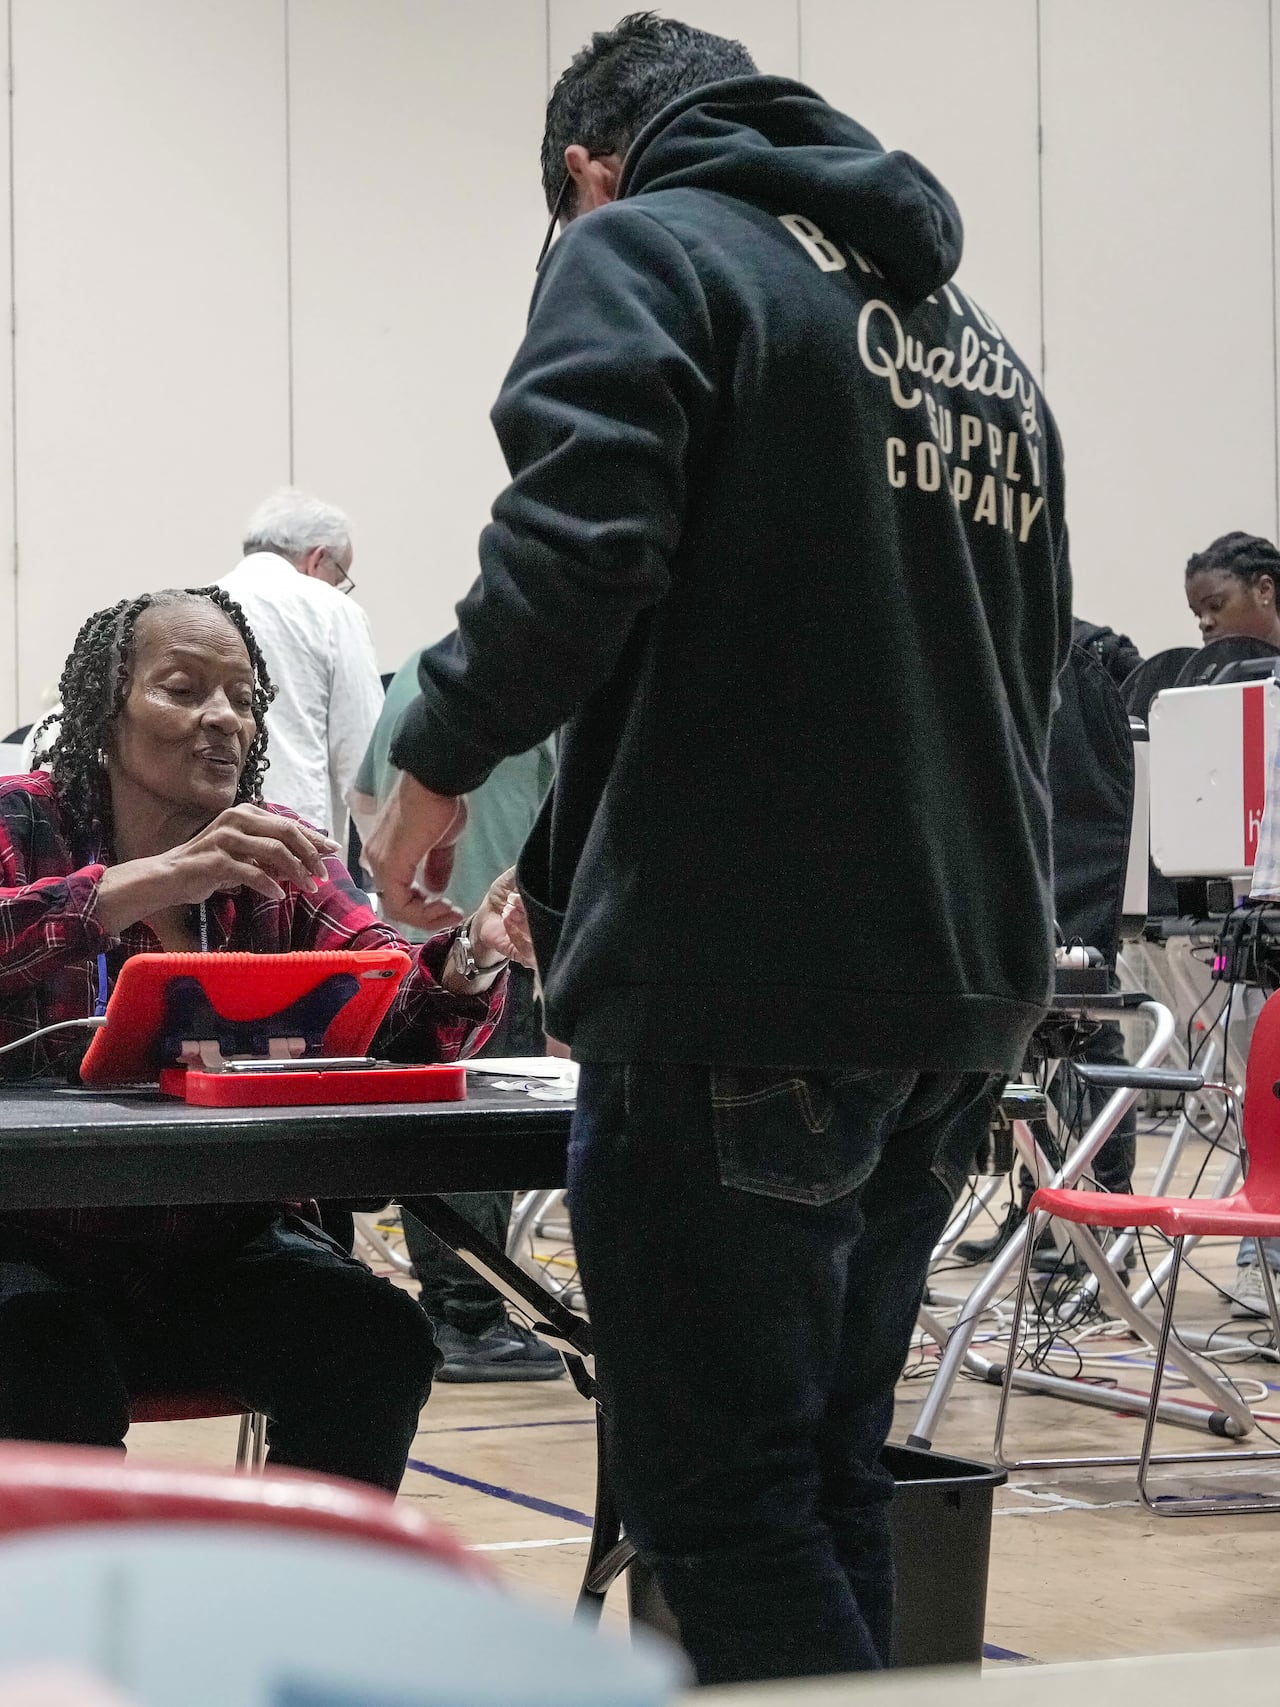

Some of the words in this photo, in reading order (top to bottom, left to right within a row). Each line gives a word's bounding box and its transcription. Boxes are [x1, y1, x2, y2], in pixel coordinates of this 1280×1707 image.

[857, 299, 1042, 438] Quality
[885, 436, 1045, 543] COPANY
[924, 392, 1041, 487] SUPPLY
